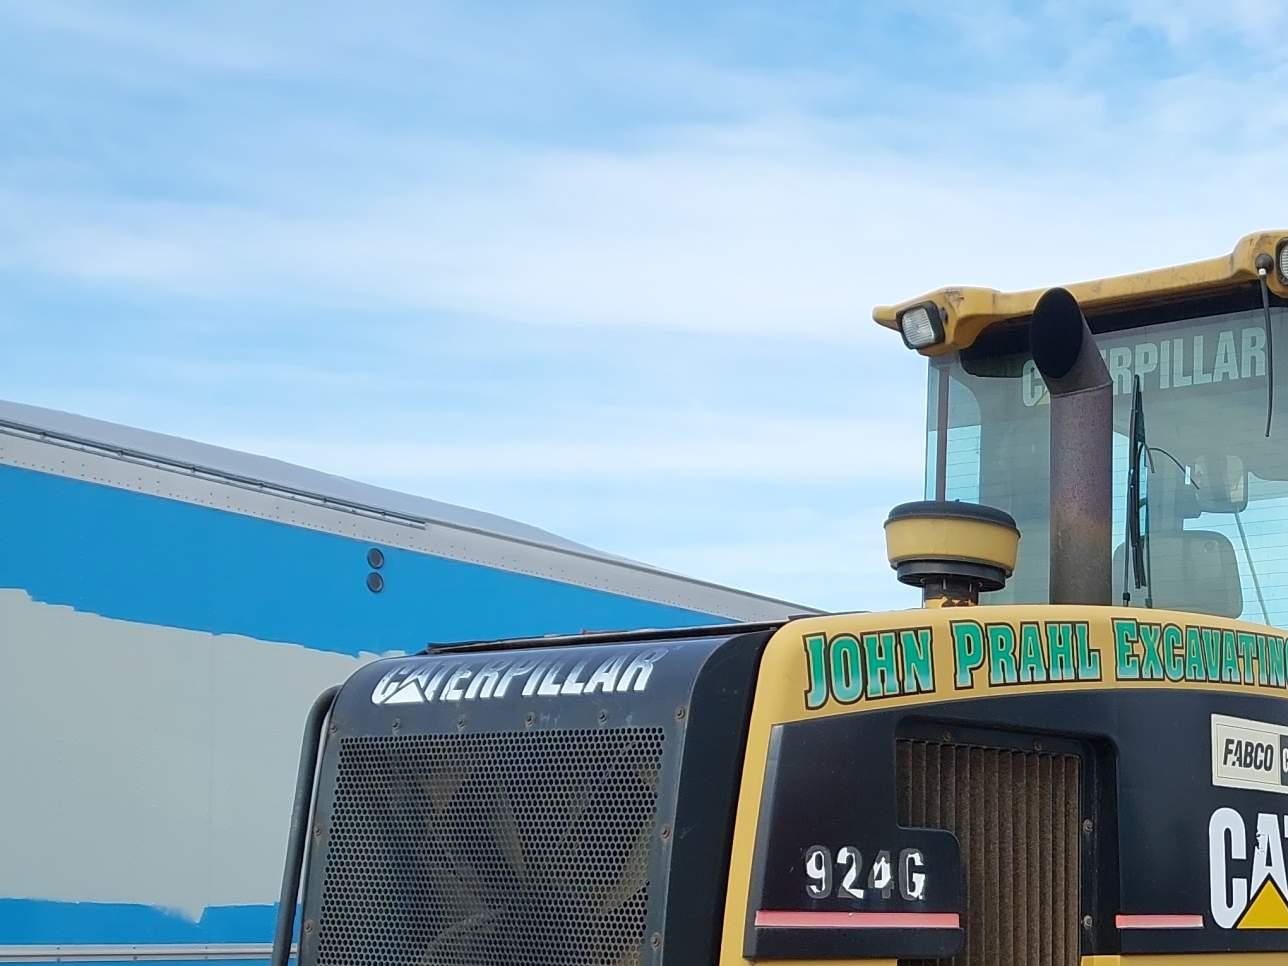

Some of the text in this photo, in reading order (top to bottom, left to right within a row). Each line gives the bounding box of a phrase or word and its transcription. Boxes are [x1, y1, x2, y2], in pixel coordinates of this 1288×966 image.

[1022, 327, 1267, 407] CRPILLAR
[371, 648, 669, 705] CATERPILLAR
[803, 626, 937, 710] JOHN
[949, 618, 1102, 690] PRAHL
[1222, 738, 1274, 772] FABCO
[805, 844, 926, 901] 924G
